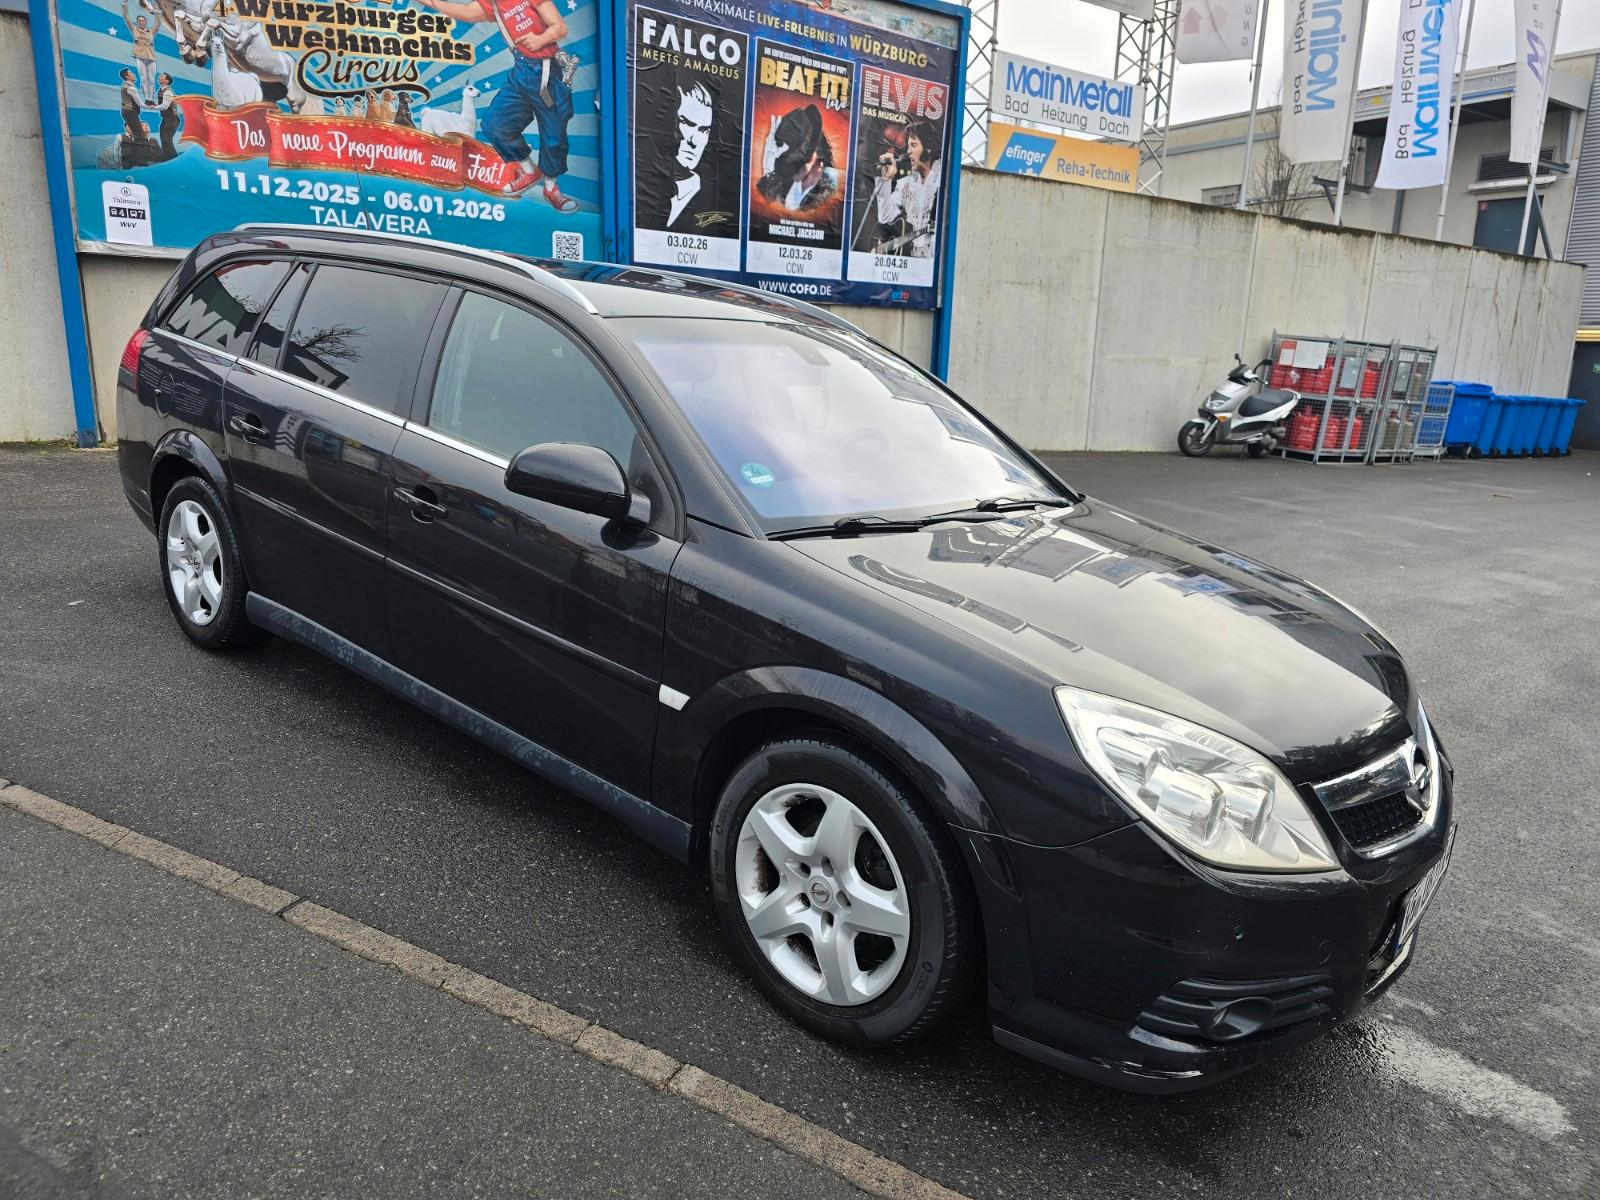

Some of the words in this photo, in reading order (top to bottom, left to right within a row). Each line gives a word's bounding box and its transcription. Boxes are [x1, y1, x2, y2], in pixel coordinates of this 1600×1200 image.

[265, 24, 473, 62] Weihnachts
[642, 17, 741, 66] FALCO
[695, 0, 755, 22] MAXIMALE
[757, 12, 835, 44] LIVE-ERLEBNIS
[836, 34, 848, 48] IN
[850, 34, 928, 68] WÜRZBURG
[297, 49, 422, 98] Circus
[642, 48, 679, 66] MEETS
[684, 58, 740, 80] AMADEUS
[760, 56, 818, 96] BEAT
[863, 70, 944, 120] ELVIS
[1006, 61, 1133, 118] MainMetall
[862, 106, 877, 117] DAS
[877, 110, 908, 124] MUSICAL
[1004, 95, 1029, 115] Bad
[1041, 103, 1088, 131] Heizung
[1099, 117, 1129, 136] Dach
[230, 119, 266, 150] Das
[282, 132, 323, 151] neue
[327, 130, 426, 170] Programm
[430, 154, 458, 173] zum
[467, 153, 505, 185] Fest!
[1006, 145, 1046, 165] efinger
[1056, 158, 1131, 184] Reha-Technik
[216, 169, 360, 206] 11.12.2025
[383, 189, 506, 222] 06.01.2026
[309, 205, 432, 236] TALAVERA
[768, 224, 796, 238] MICHAEL
[797, 227, 825, 241] JACKSON
[667, 235, 708, 251] 03.02.26
[677, 252, 698, 265] CCW
[778, 246, 813, 261] 12.03.26
[786, 263, 805, 275] CCW
[874, 256, 908, 269] 20.04.26
[882, 271, 900, 282] CCW
[758, 280, 832, 297] WWW.COFO.DE
